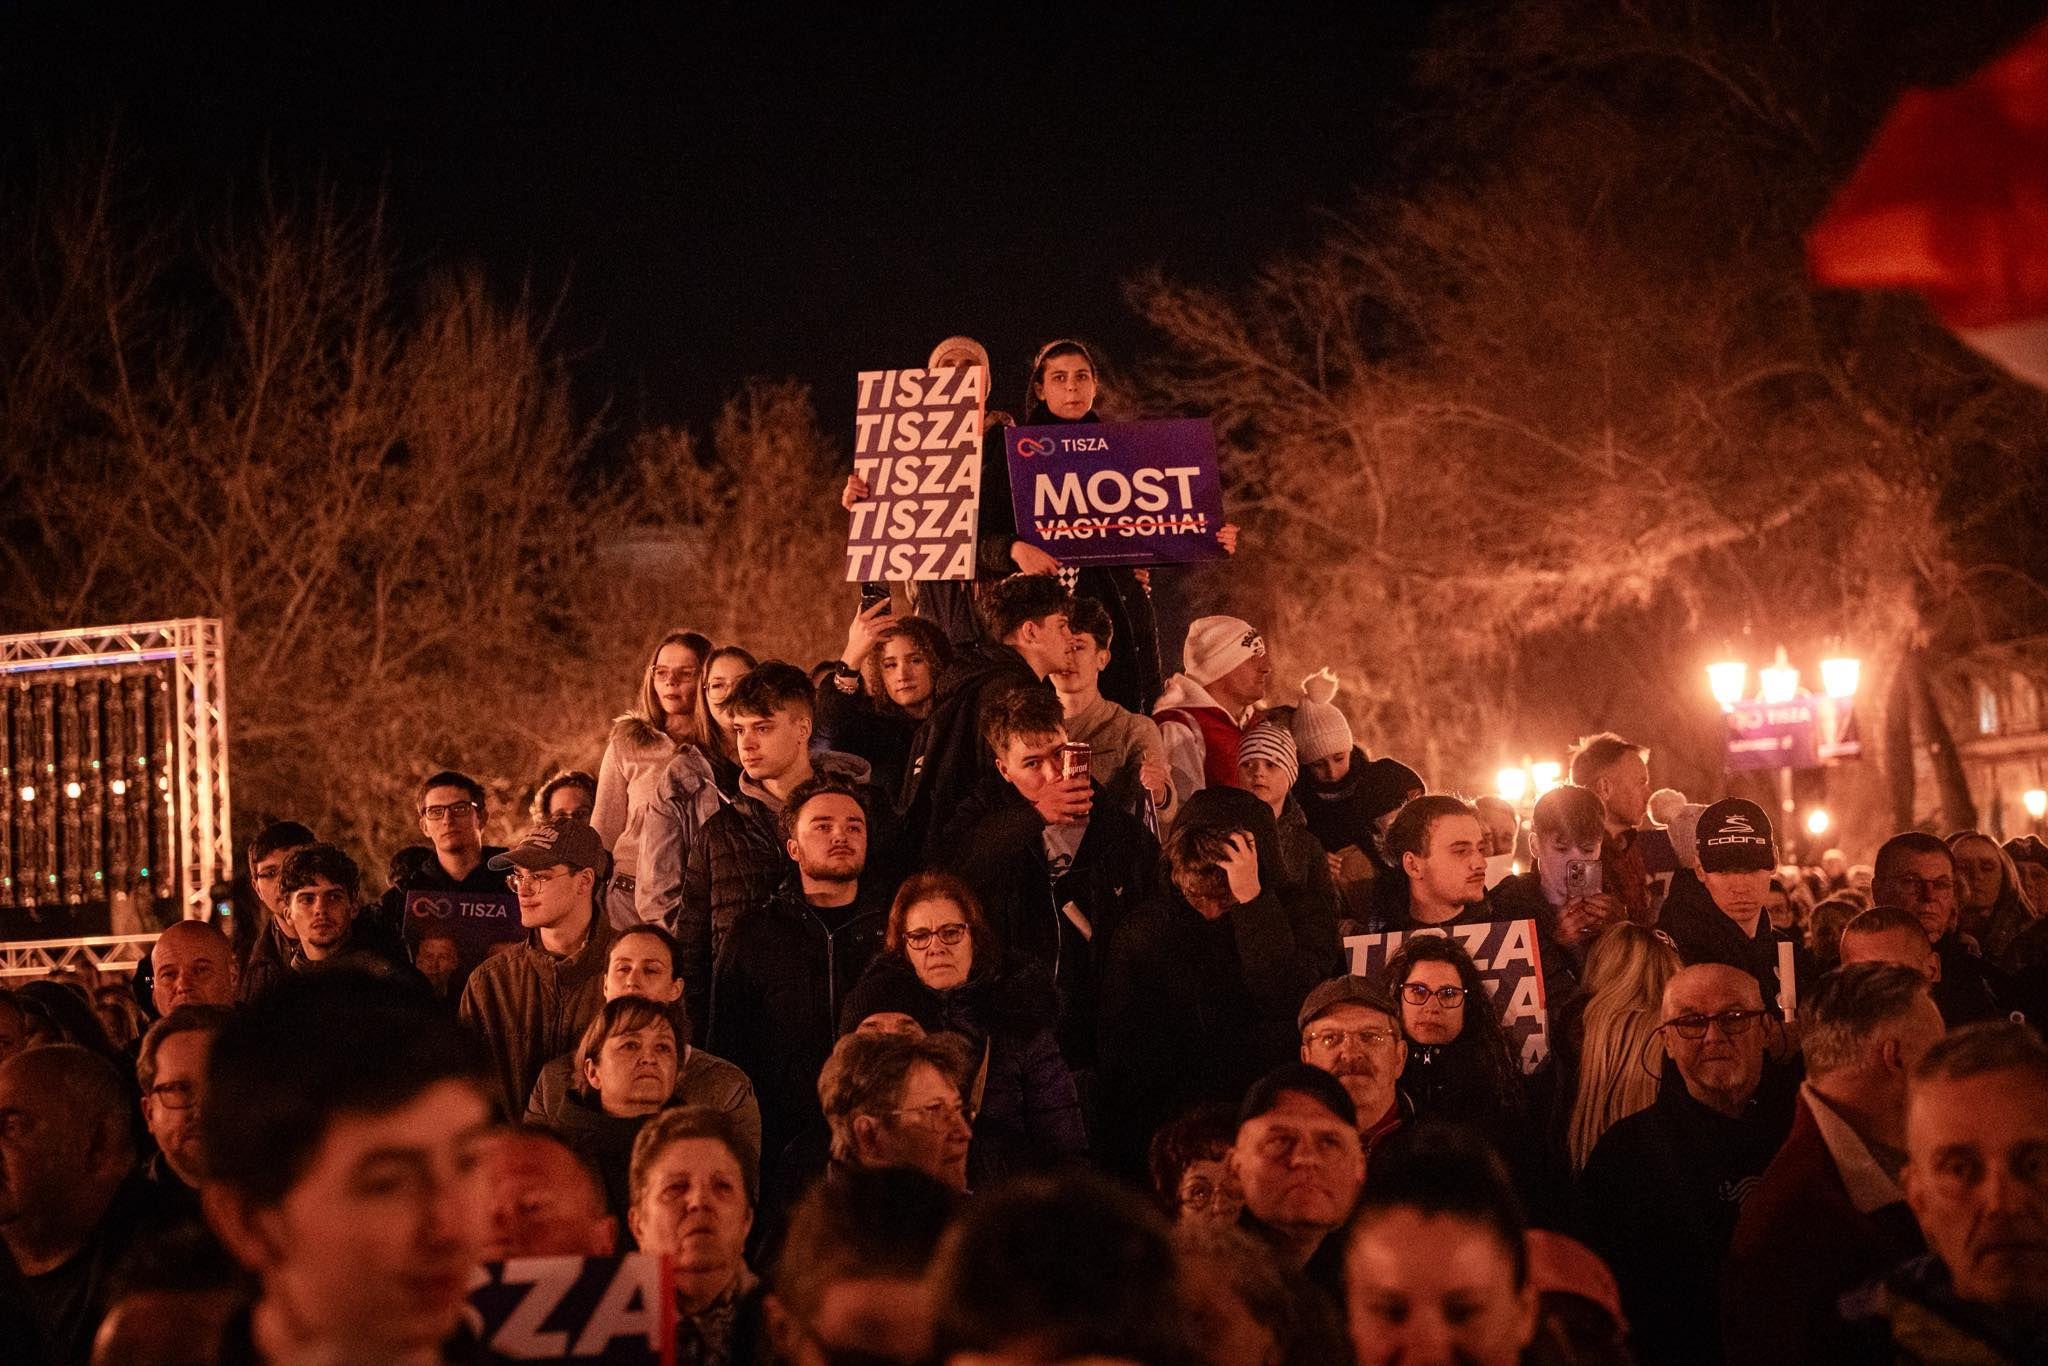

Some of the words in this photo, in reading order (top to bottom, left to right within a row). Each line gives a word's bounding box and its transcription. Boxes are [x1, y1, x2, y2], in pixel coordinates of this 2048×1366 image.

[858, 365, 982, 409] TISZA
[855, 410, 980, 453] TISZA
[1061, 438, 1109, 452] TISZA
[853, 454, 977, 496] TISZA
[1034, 466, 1200, 516] MOST
[849, 499, 973, 540] TISZA
[1034, 516, 1110, 541] VAGY
[1118, 512, 1207, 537] SOHA!
[846, 543, 972, 581] TISZA
[1707, 834, 1766, 846] cobra
[460, 902, 507, 918] TISZA
[1343, 919, 1535, 977] TIZA
